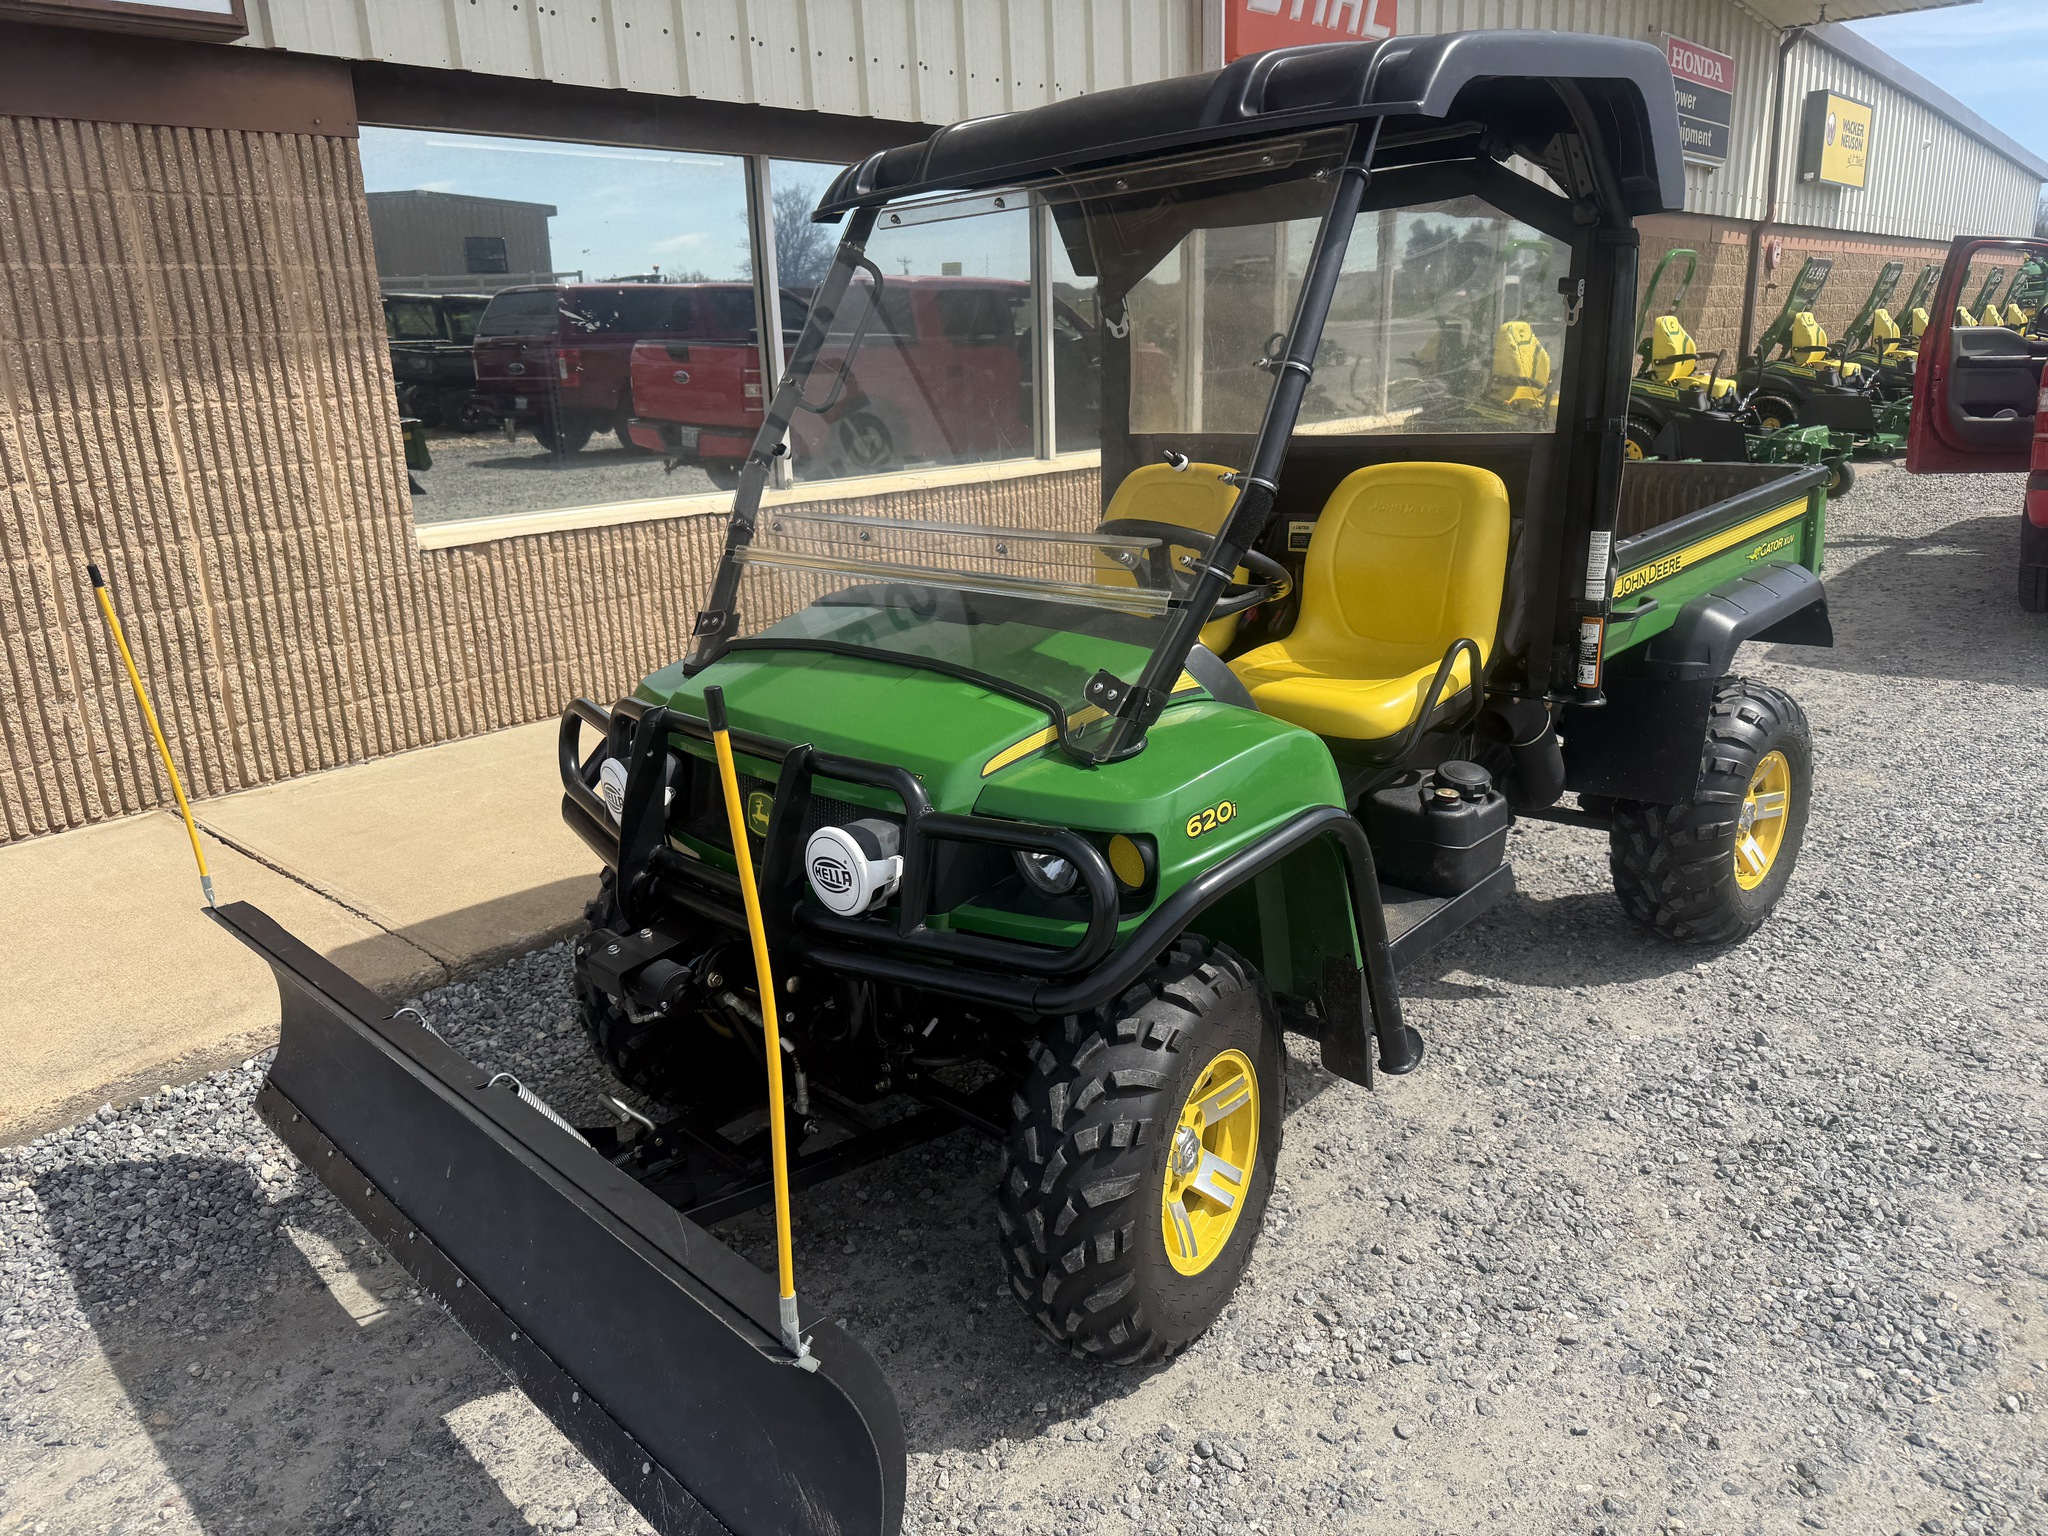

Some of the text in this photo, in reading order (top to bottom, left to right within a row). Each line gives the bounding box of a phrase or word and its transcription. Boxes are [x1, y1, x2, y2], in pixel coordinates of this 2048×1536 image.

[1671, 46, 1723, 83] HONDA
[1674, 90, 1697, 110] ower
[1680, 121, 1712, 147] ipment
[1843, 118, 1864, 138] WACKER
[1841, 133, 1863, 151] NEUSON
[1760, 533, 1795, 557] GATOR XUV
[1617, 569, 1648, 597] JOHN
[1648, 555, 1682, 583] DEERE
[1186, 801, 1237, 838] 620i
[815, 866, 853, 888] HELLA
